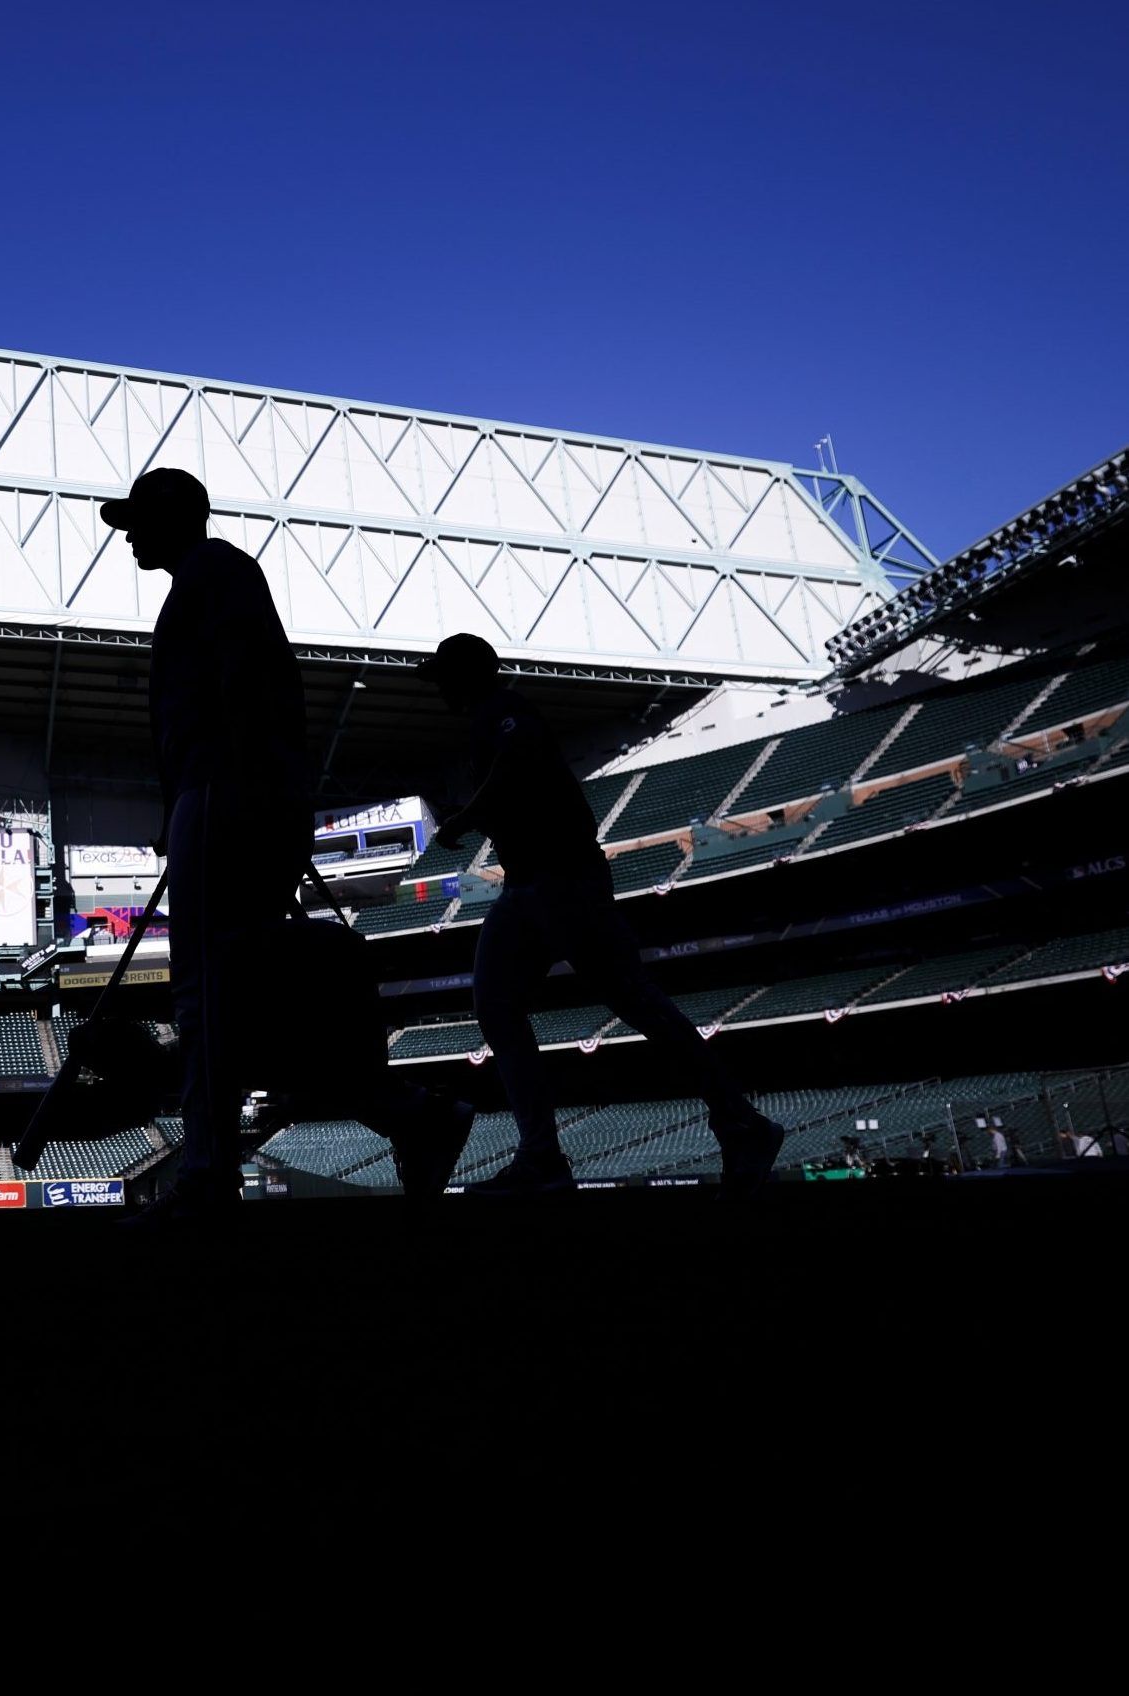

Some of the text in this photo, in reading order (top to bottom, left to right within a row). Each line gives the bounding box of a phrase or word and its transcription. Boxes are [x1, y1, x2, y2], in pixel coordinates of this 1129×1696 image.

[337, 807, 402, 827] ULTRA
[76, 849, 118, 863] Texas
[1088, 856, 1126, 876] ALCS
[64, 972, 163, 985] DOGGET RENTS
[71, 1183, 109, 1193] ENERGY
[71, 1193, 122, 1203] TRANSFER
